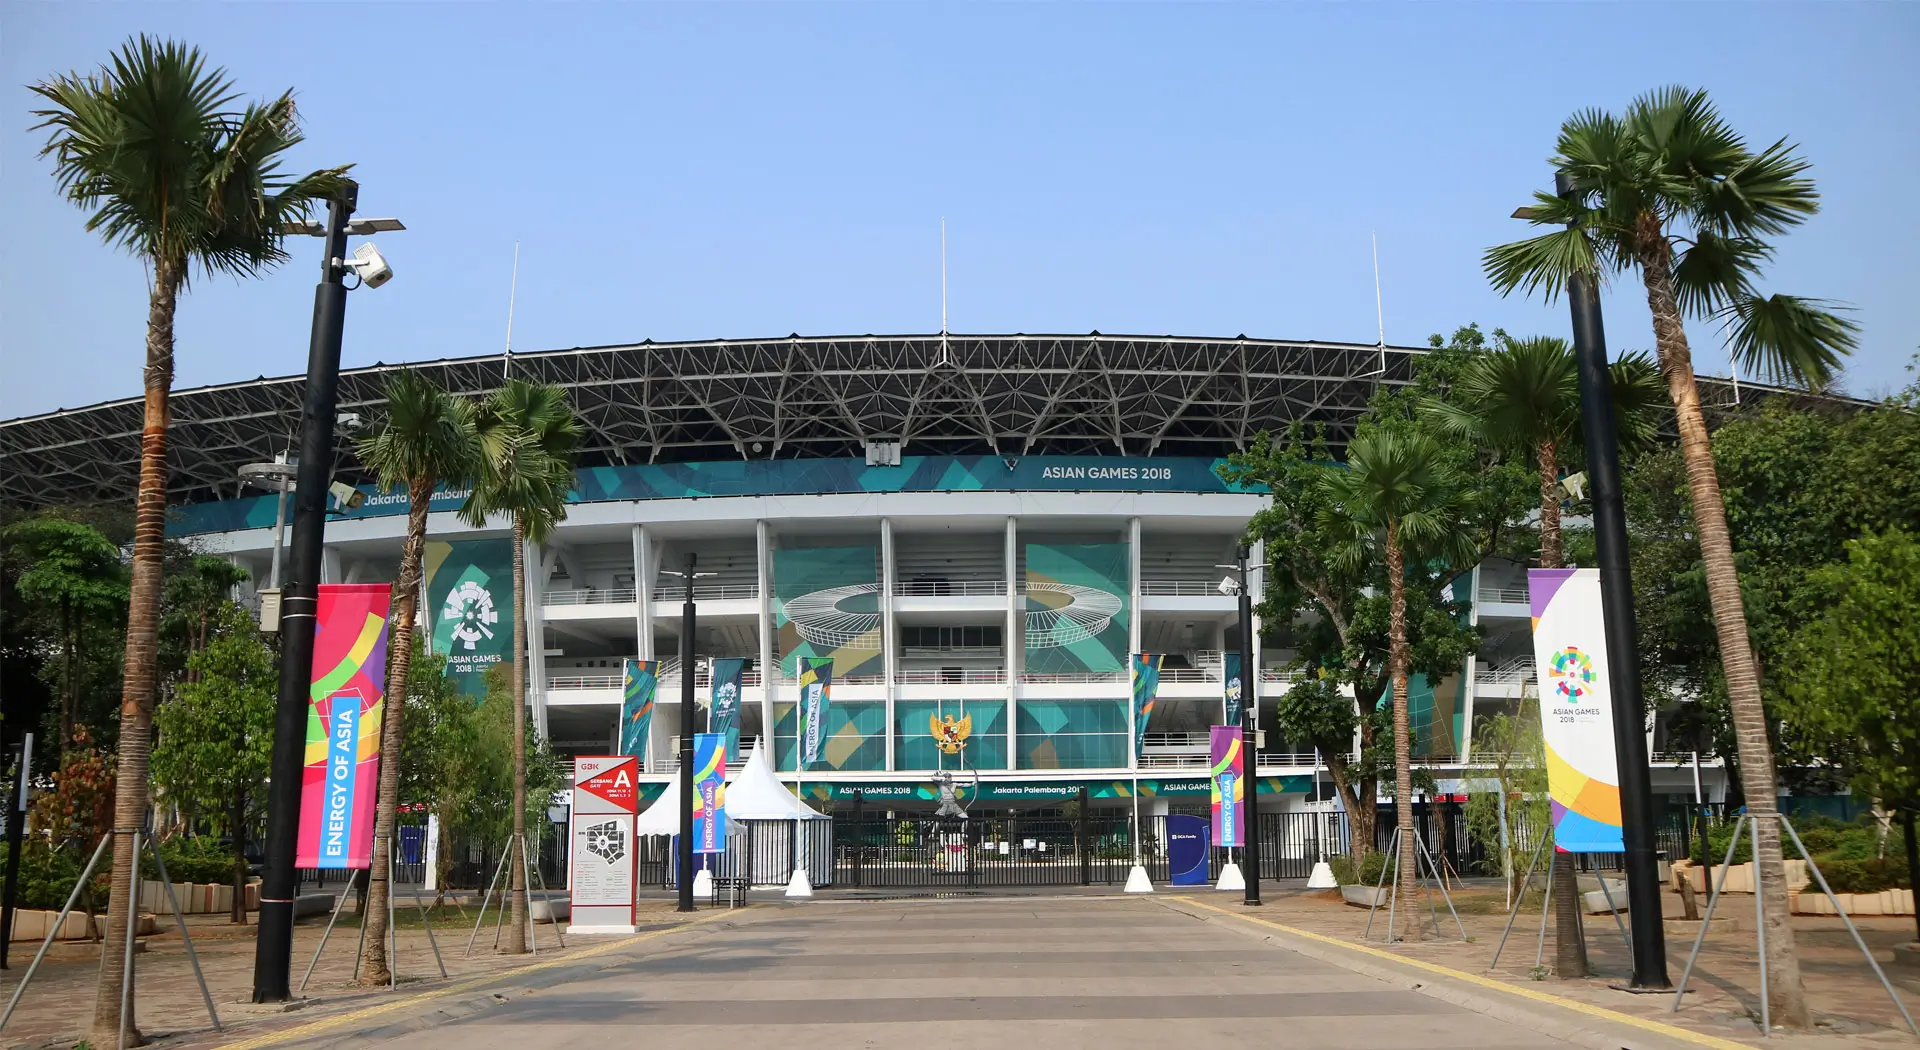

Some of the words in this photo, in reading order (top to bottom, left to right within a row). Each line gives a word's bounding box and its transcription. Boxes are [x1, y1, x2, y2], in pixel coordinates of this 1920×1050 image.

[1042, 466, 1085, 479] ASIAN
[1088, 467, 1138, 480] GAMES
[1141, 468, 1172, 480] 2018
[364, 493, 408, 506] Jakarta
[448, 655, 471, 663] ASIAN
[472, 654, 502, 663] GAMES
[455, 664, 472, 673] 2018
[811, 689, 820, 709] ASIA
[1574, 708, 1600, 716] GAMES
[336, 709, 353, 753] ASIA
[333, 755, 349, 781] OF
[613, 769, 631, 788] A
[705, 786, 713, 805] ASIA
[864, 787, 892, 795] GAMES
[993, 786, 1023, 794] Jakarta
[1024, 786, 1067, 795] Palembang
[1067, 785, 1085, 793] 201
[705, 805, 713, 817] OF
[1224, 799, 1231, 810] OF
[326, 783, 348, 856] ENERGY
[1224, 810, 1232, 842] ENERGY
[705, 818, 713, 849] ENERGY
